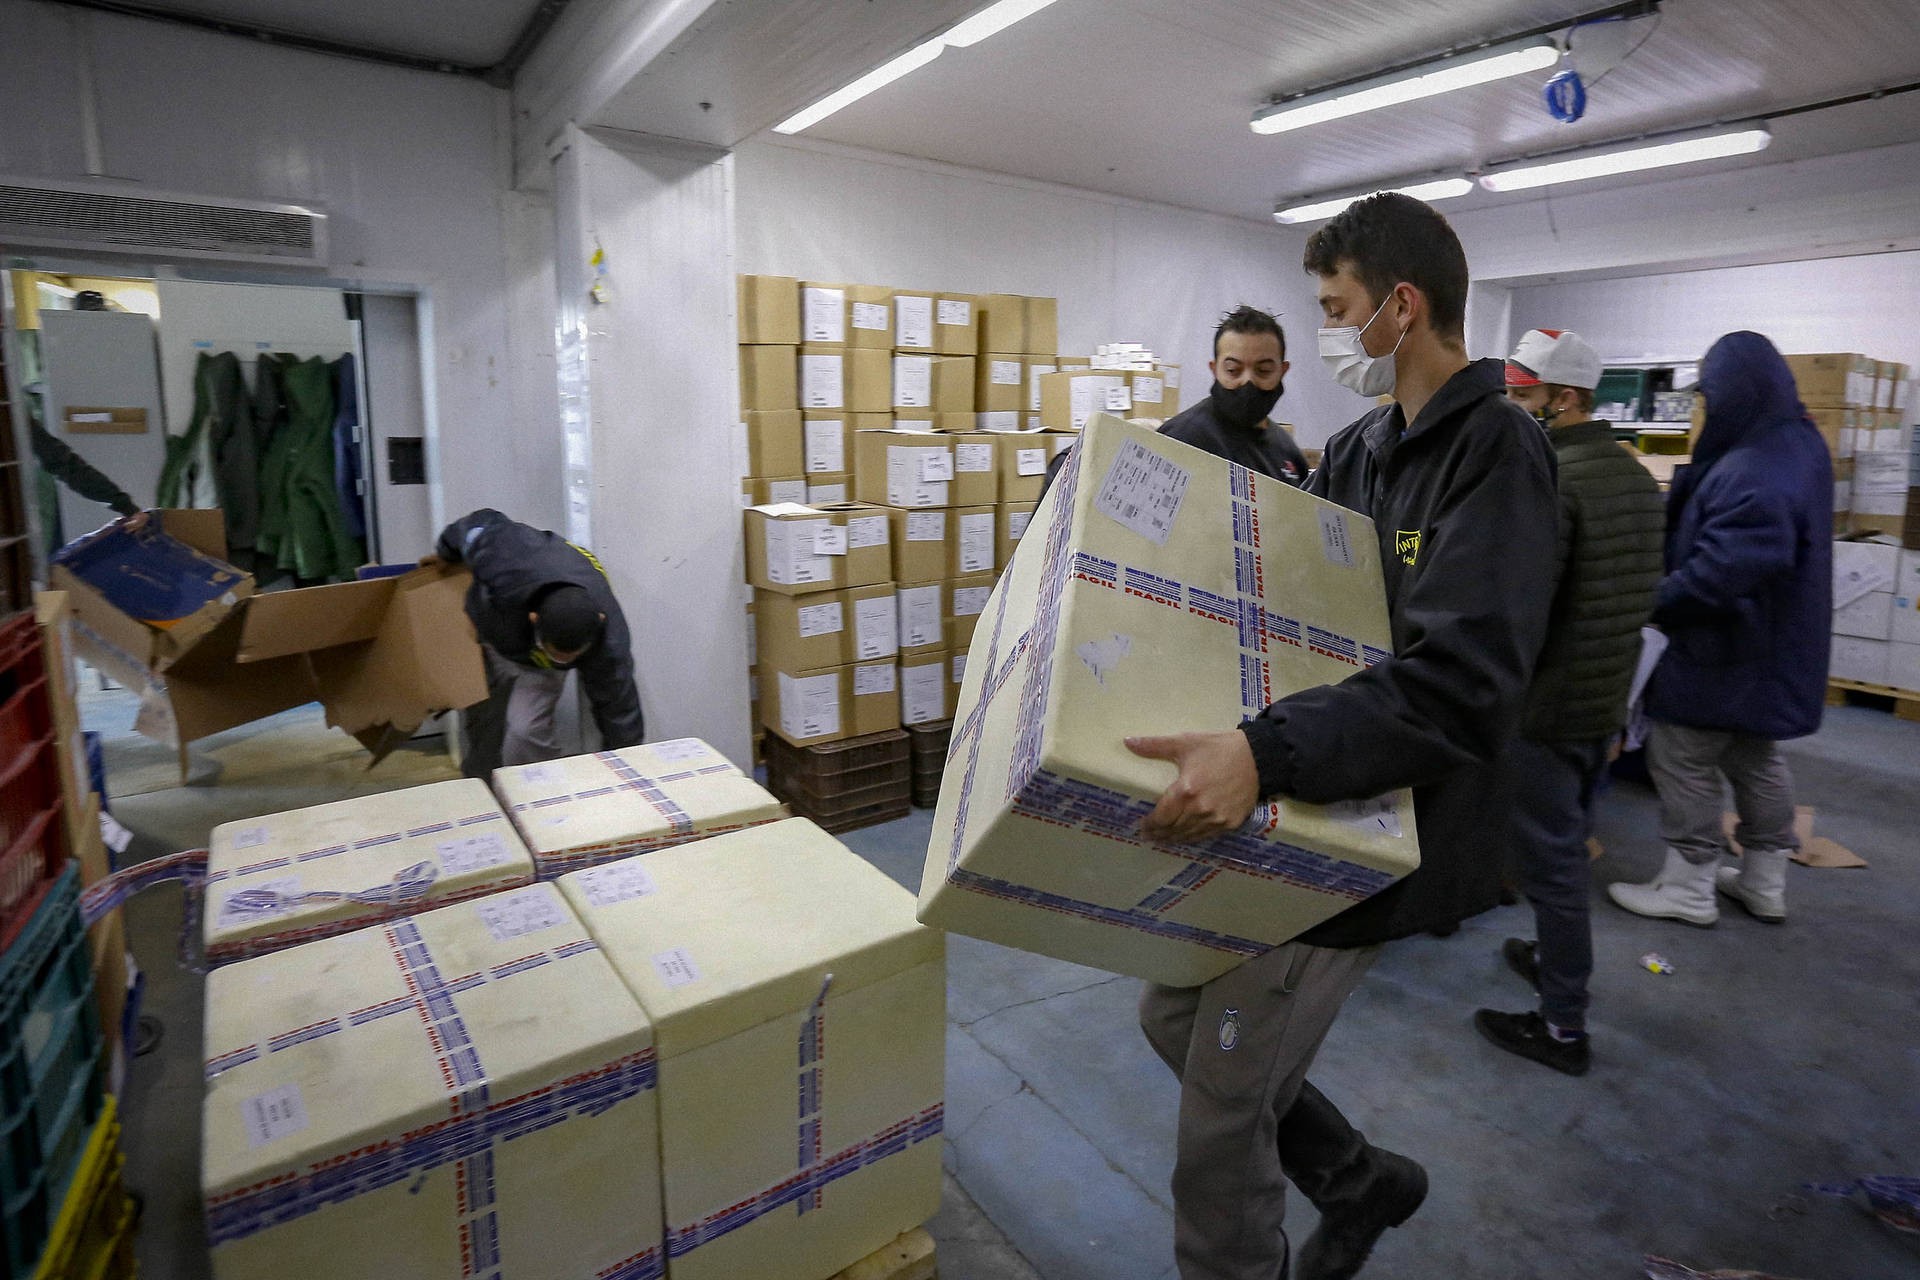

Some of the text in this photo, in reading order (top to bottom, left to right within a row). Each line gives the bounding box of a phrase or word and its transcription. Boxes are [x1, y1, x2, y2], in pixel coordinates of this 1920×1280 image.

[1248, 470, 1256, 503] FRÁGI
[1251, 507, 1260, 548] FRÁGIL
[1255, 554, 1264, 599] FRÁGIL
[1125, 587, 1181, 610] FRÁGIL
[1309, 645, 1359, 667] FRÁGIL
[1263, 660, 1272, 705] RÁGIL
[308, 1138, 391, 1171] FRÁGIL
